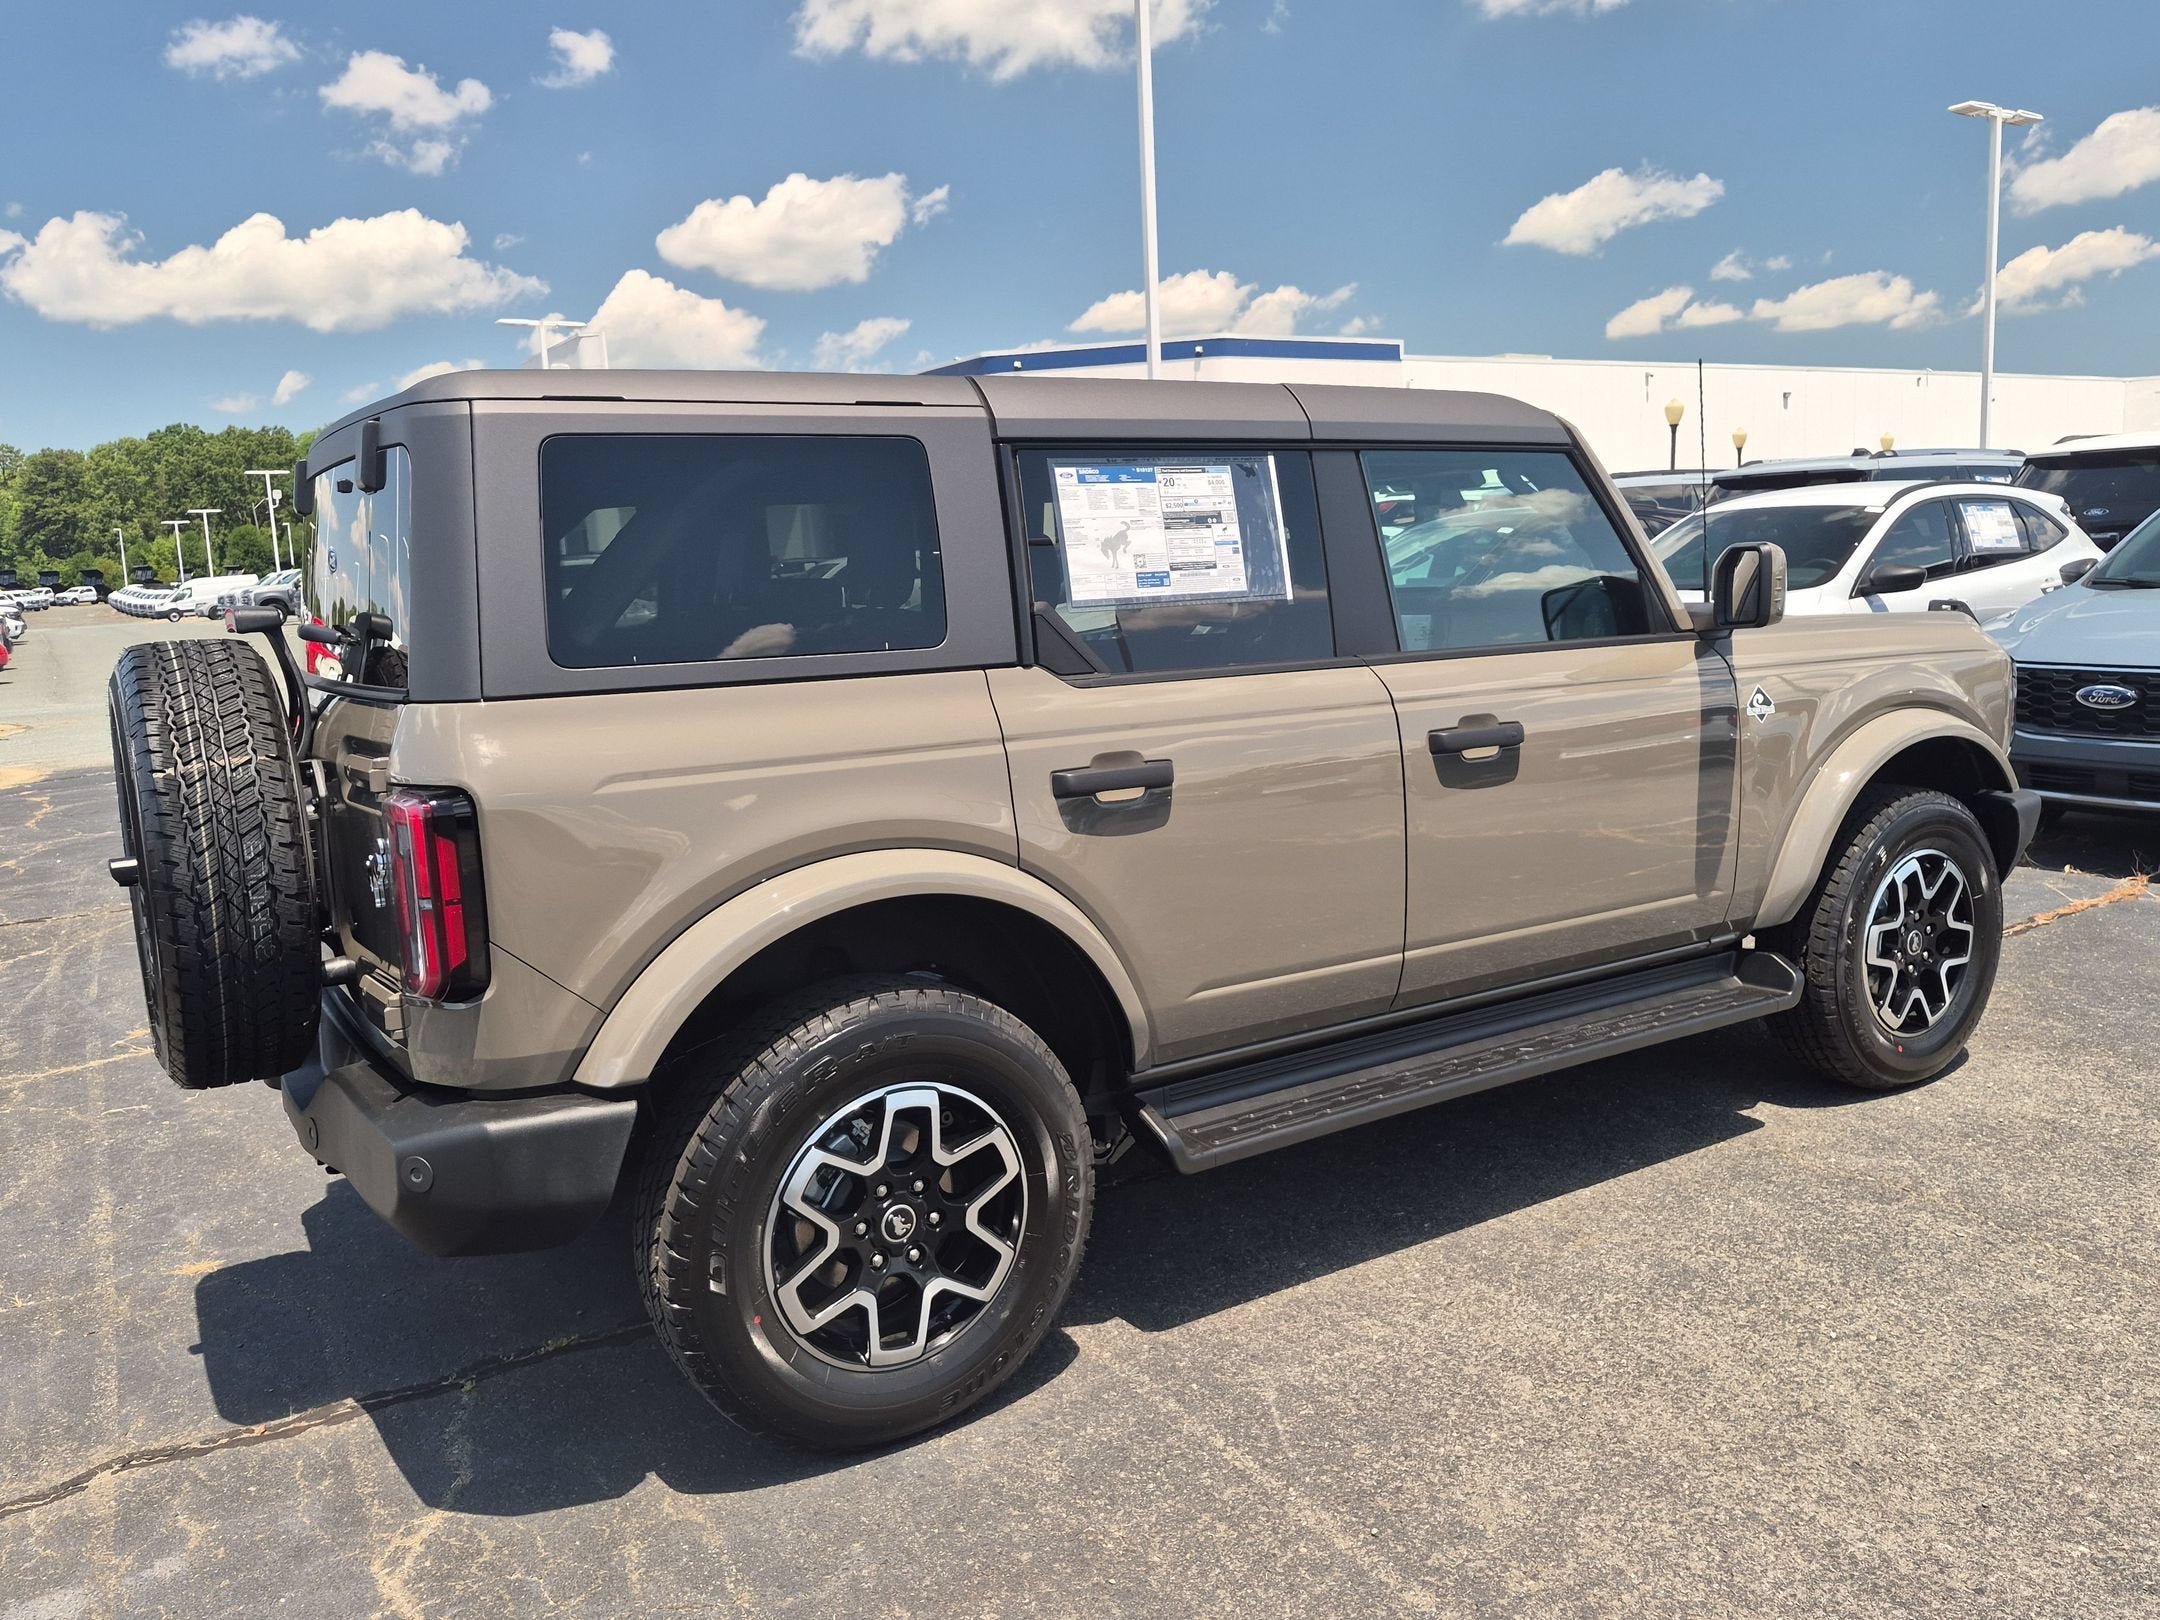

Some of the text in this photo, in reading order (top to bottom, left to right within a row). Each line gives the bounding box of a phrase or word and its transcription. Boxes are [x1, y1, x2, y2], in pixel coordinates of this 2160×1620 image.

[1162, 477, 1175, 487] 20
[2088, 689, 2122, 704] Ford
[855, 1032, 917, 1064] A/T
